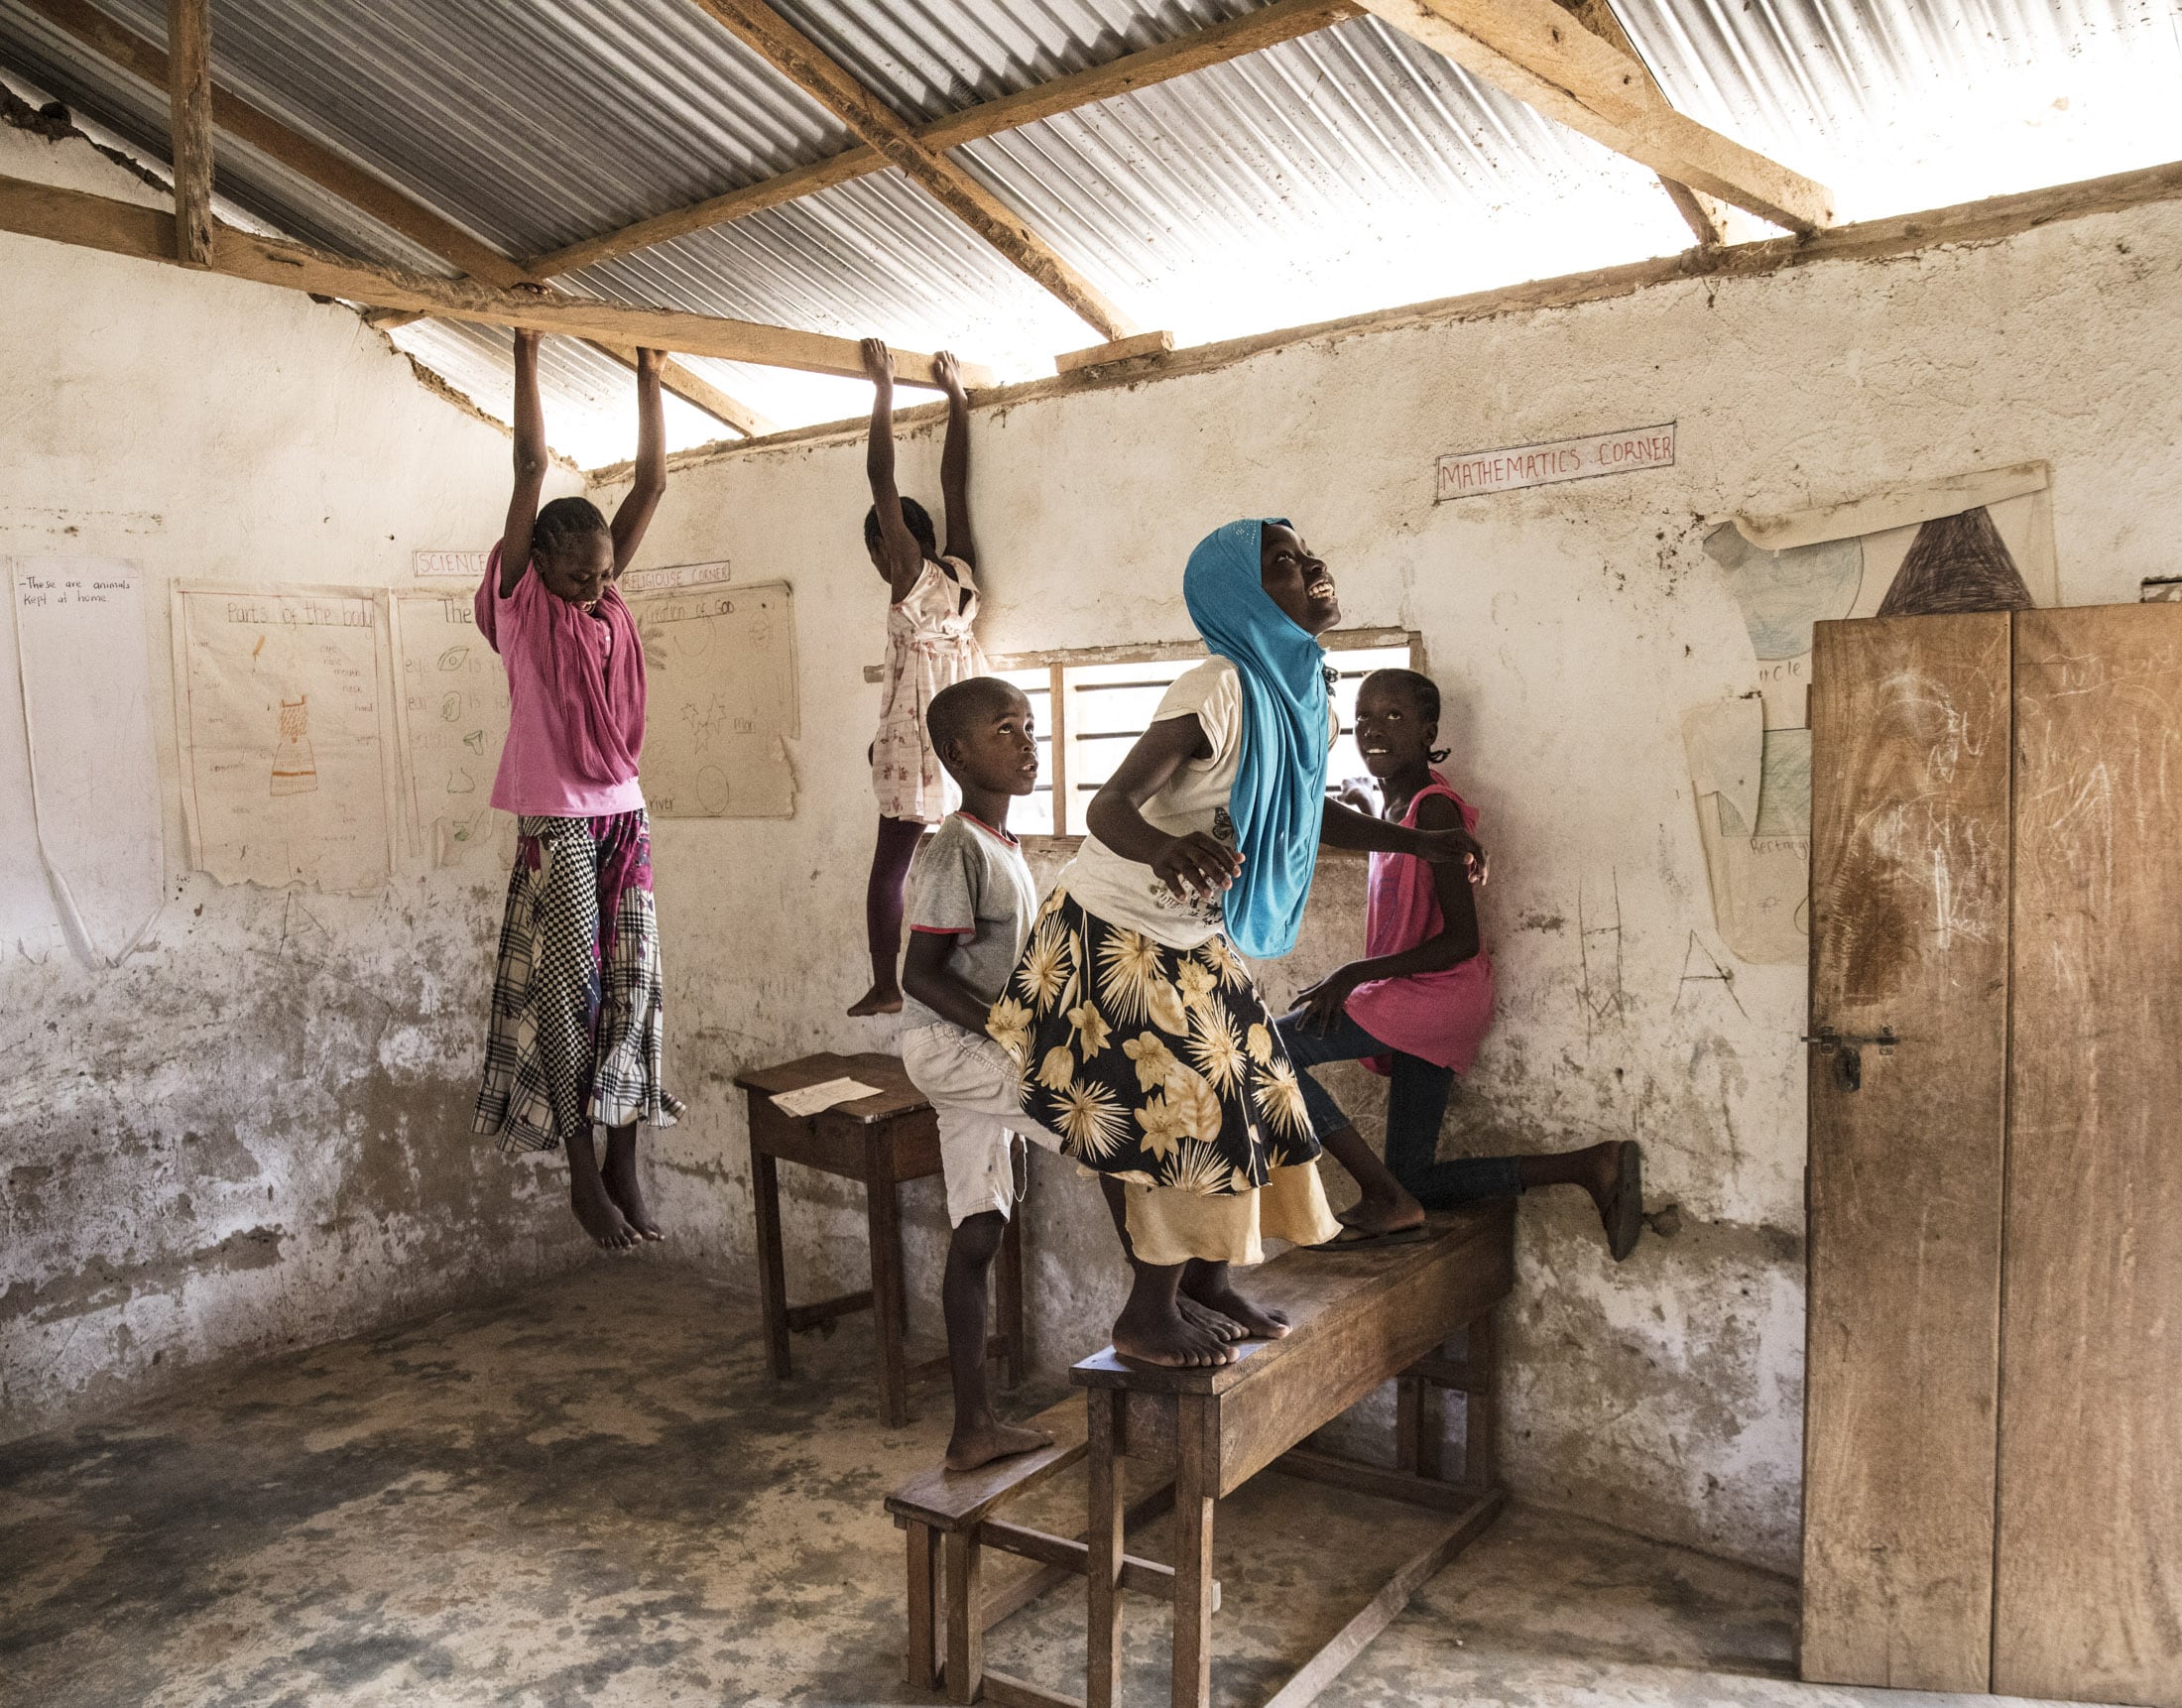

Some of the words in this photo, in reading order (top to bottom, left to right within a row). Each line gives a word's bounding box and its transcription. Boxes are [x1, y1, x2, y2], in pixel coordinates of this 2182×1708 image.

[1442, 449, 1581, 490] MATHEMATICS
[1599, 435, 1674, 466] CORNER
[419, 553, 487, 573] SCIENCE
[64, 579, 82, 589] are
[92, 578, 131, 589] animals
[691, 565, 728, 583] CORNER
[57, 591, 68, 604] at
[227, 602, 269, 624] Parts
[303, 598, 332, 625] the
[342, 598, 374, 640] body
[436, 598, 472, 624] The
